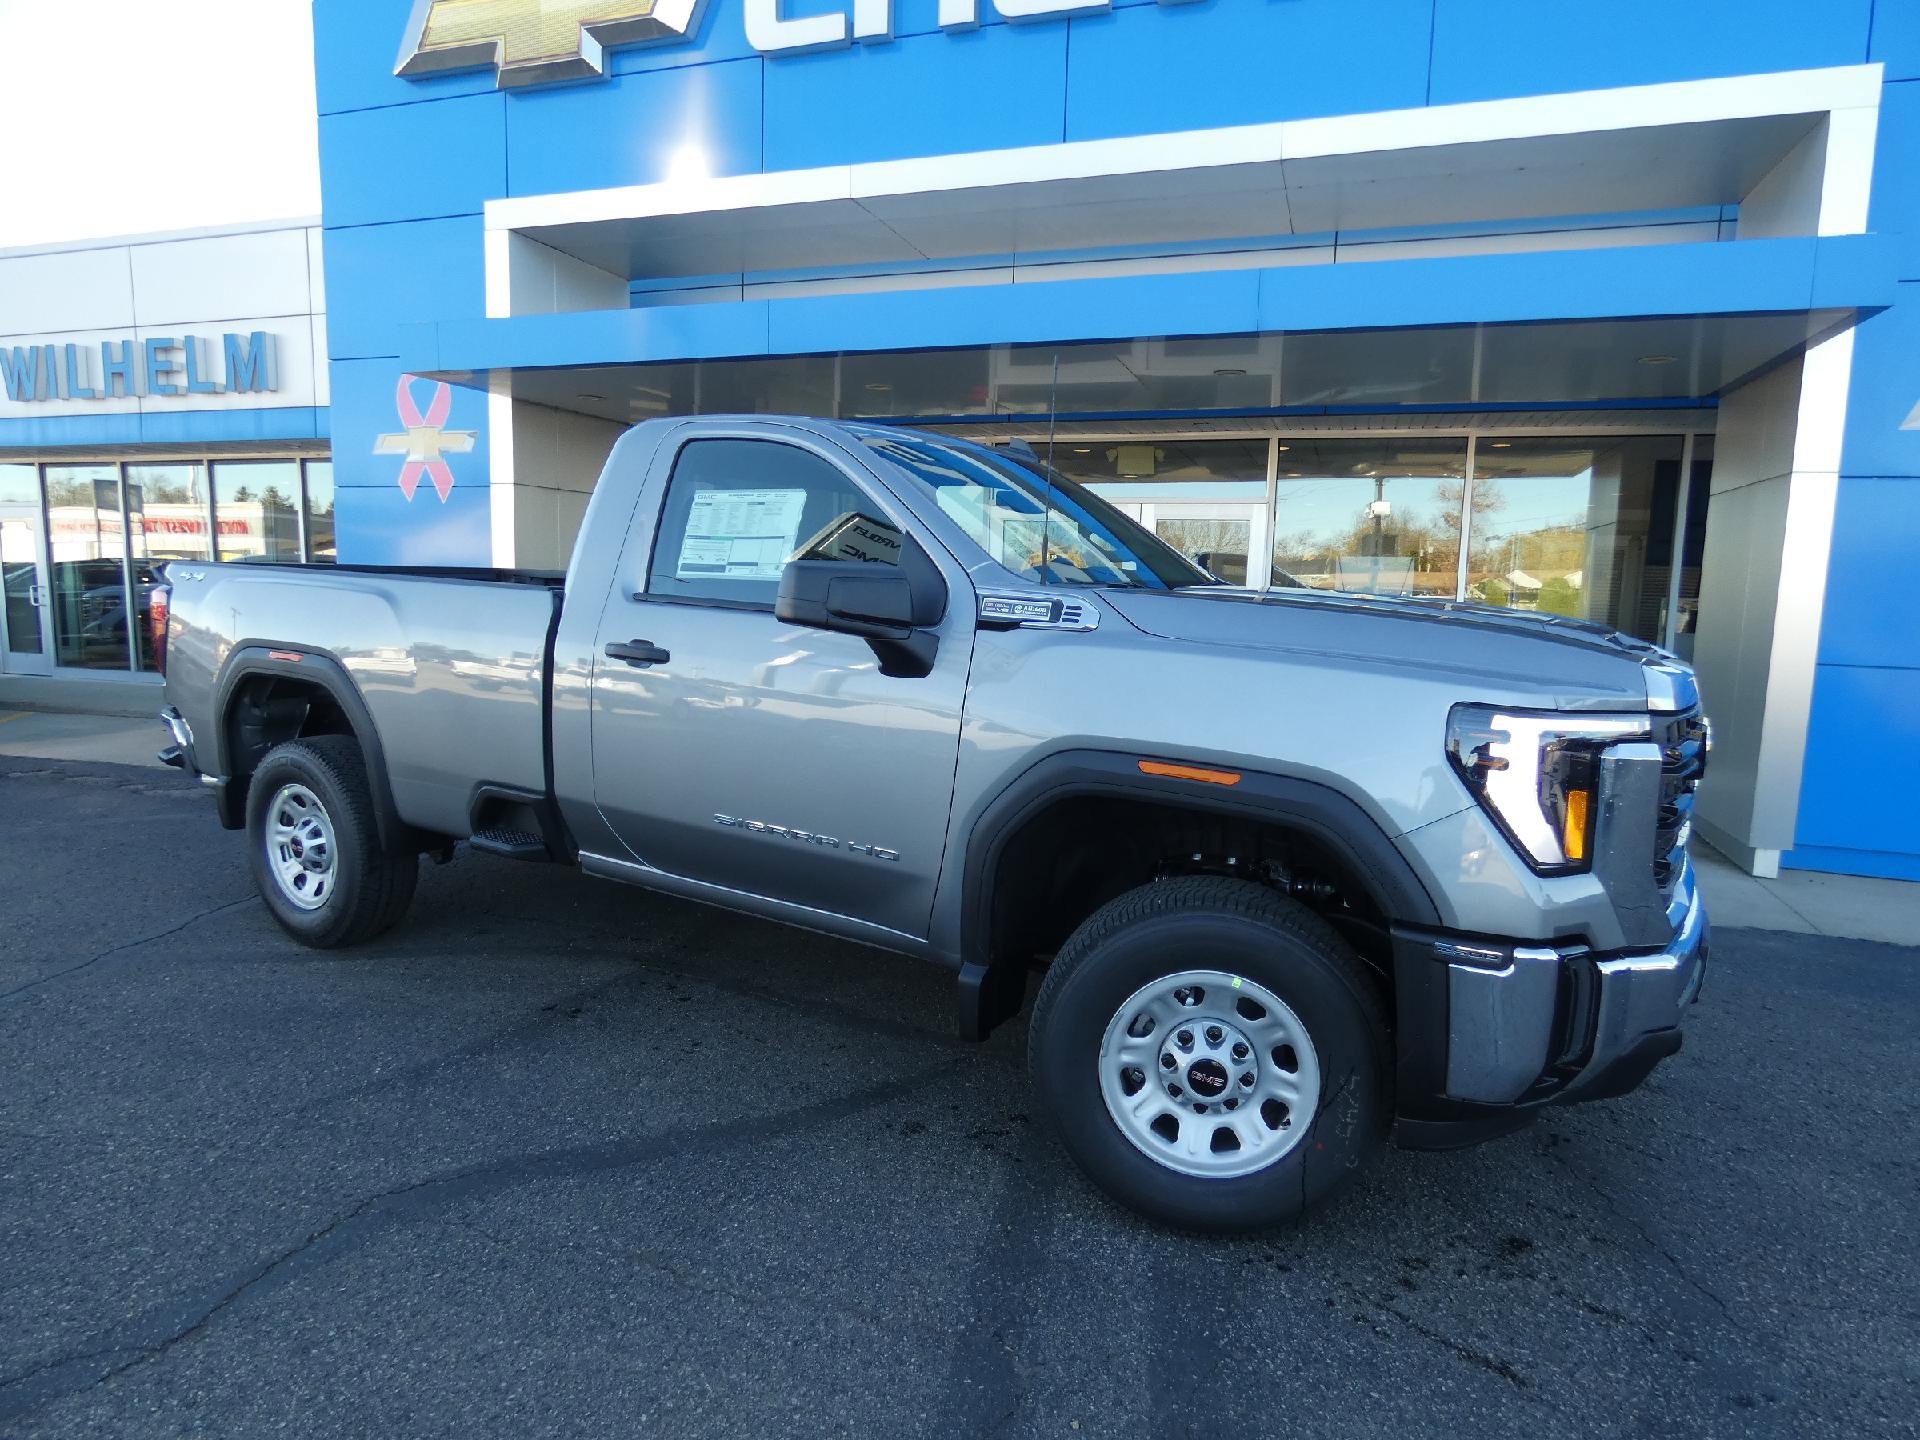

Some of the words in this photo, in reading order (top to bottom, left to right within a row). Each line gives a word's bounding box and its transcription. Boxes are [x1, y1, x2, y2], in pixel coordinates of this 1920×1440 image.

[0, 331, 278, 402] WILHELM
[713, 812, 841, 849] SIERRA
[847, 840, 900, 862] HD
